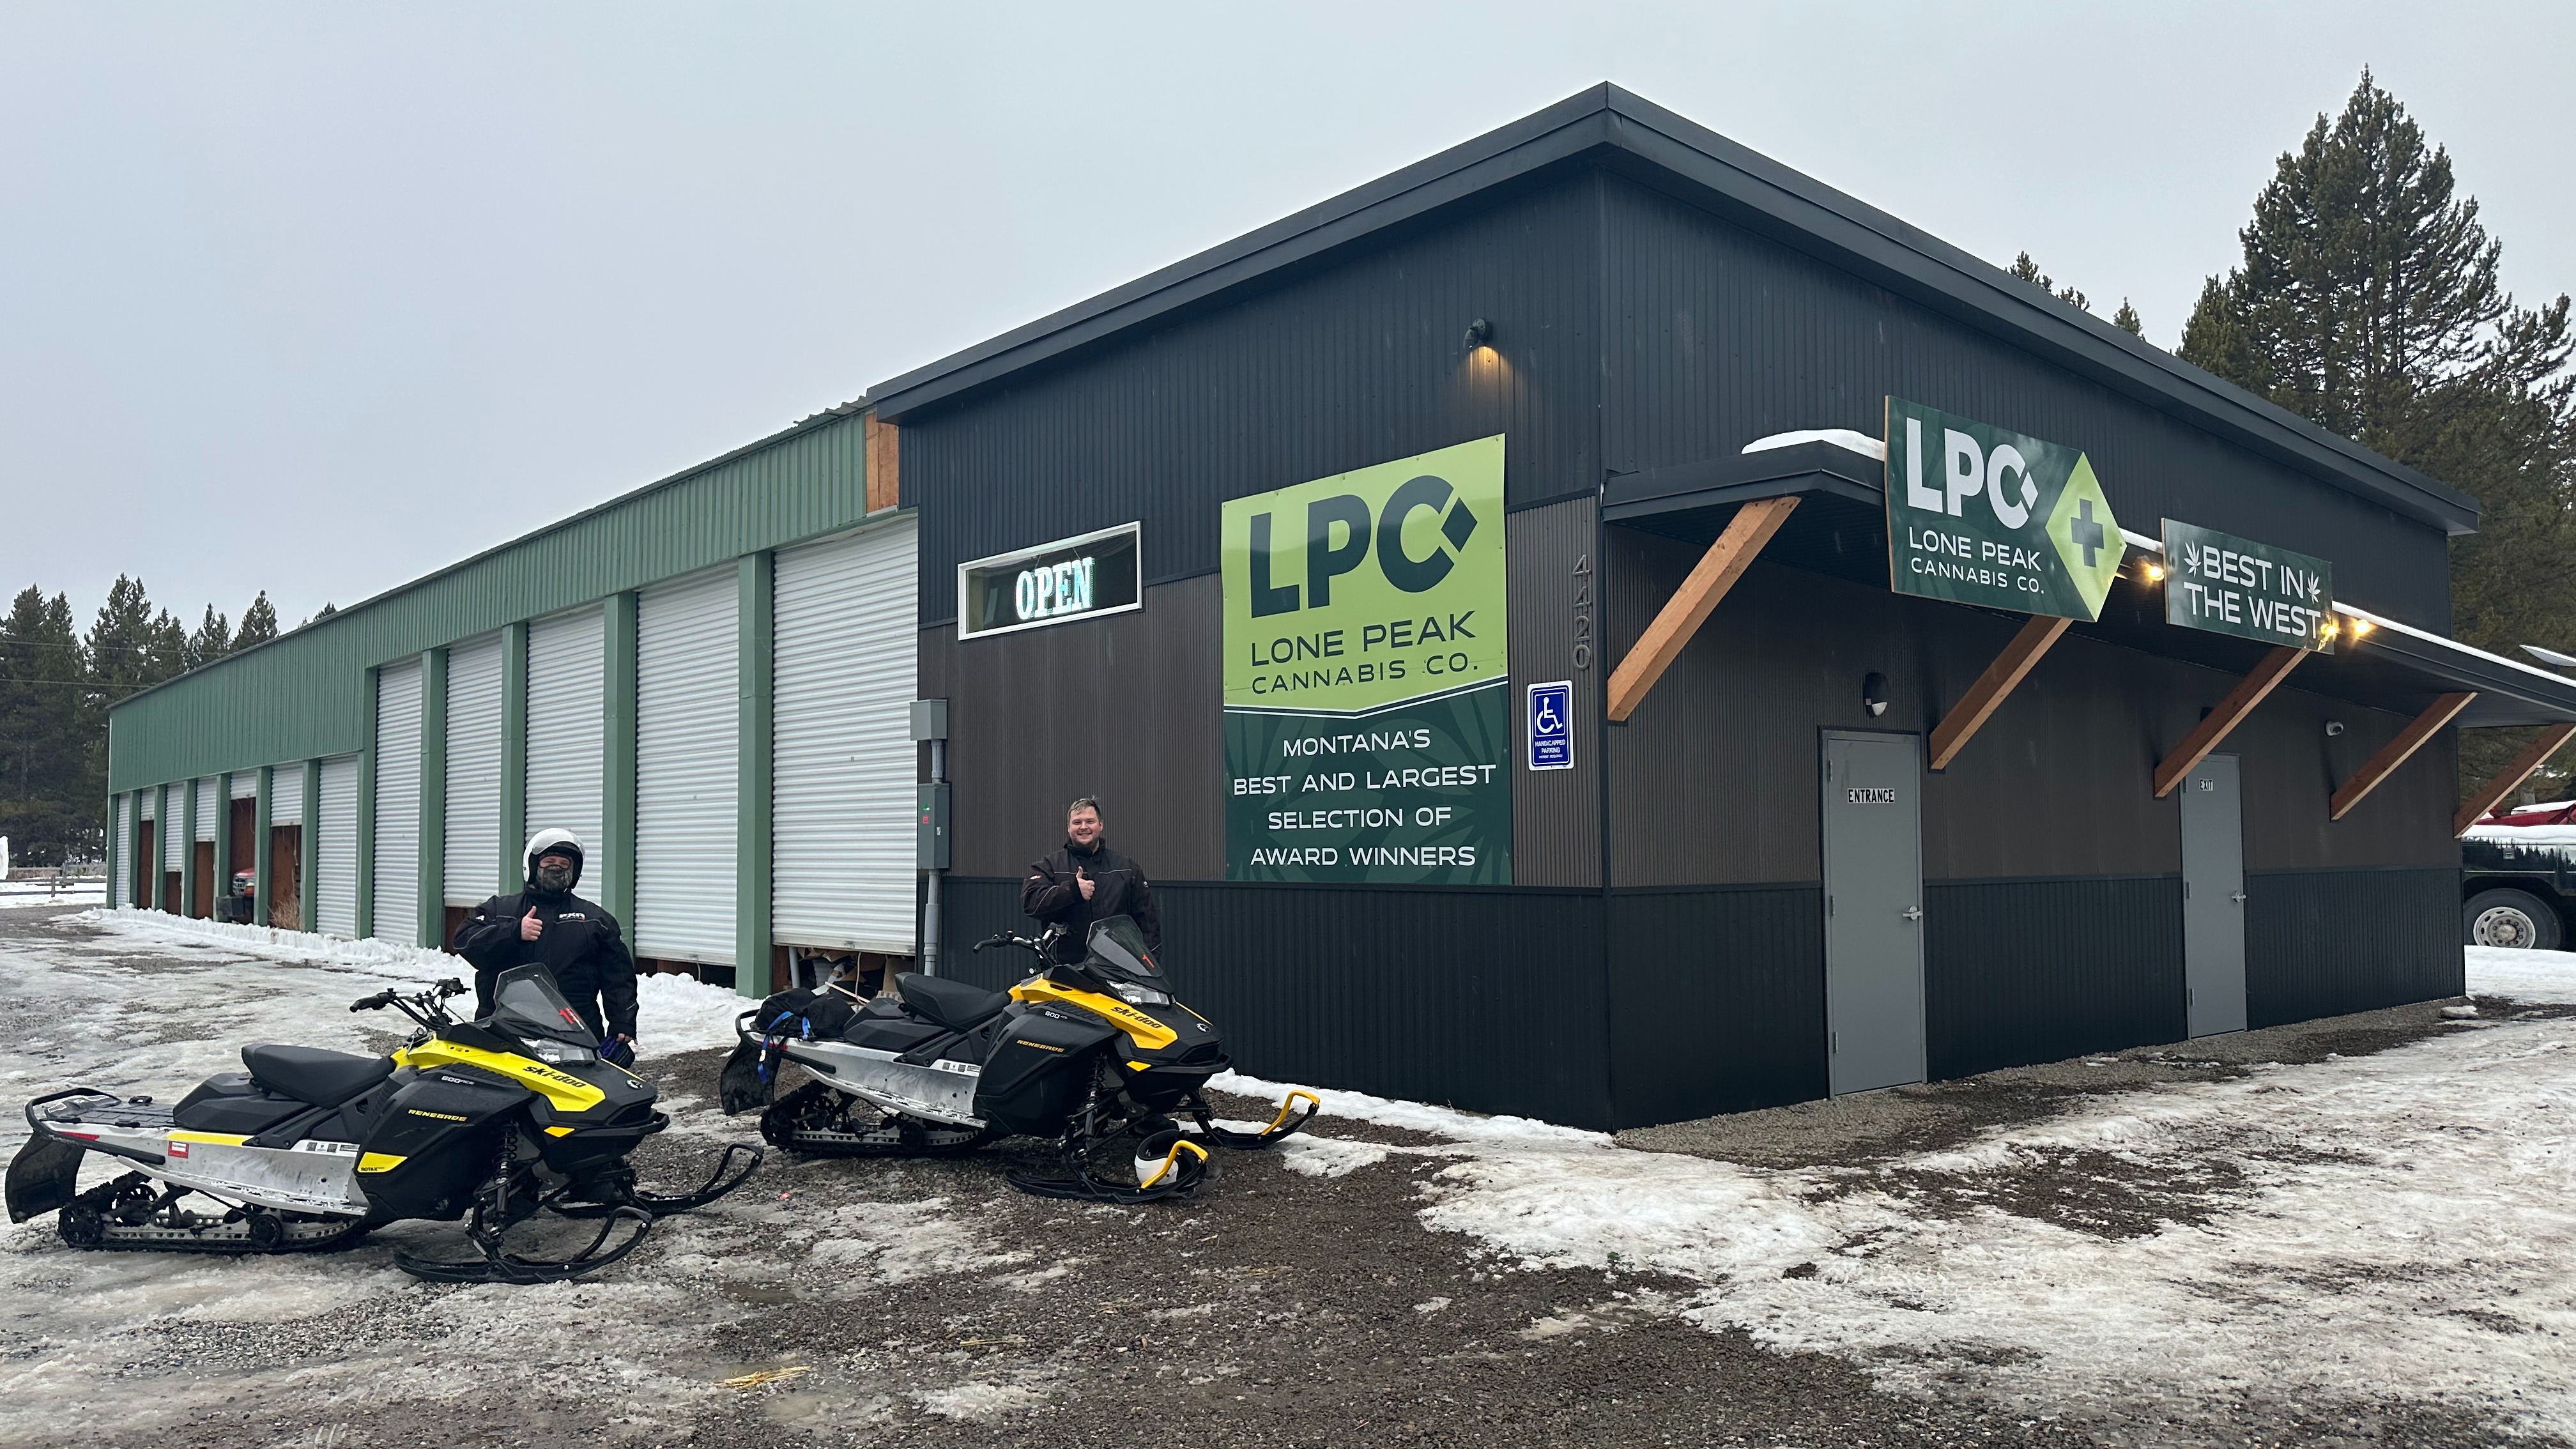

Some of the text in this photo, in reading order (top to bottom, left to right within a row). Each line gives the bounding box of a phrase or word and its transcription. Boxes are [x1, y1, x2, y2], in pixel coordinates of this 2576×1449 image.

[1906, 417, 2029, 529] LPC
[1250, 475, 1455, 618] LPC
[1909, 527, 2042, 572] LONE PEAK
[1016, 556, 1094, 620] OPEN
[1911, 557, 2044, 594] CANNABIS CO.
[2203, 546, 2304, 599] BEST IN
[1572, 555, 1593, 670] 4420
[2184, 582, 2321, 639] THE WEST
[1252, 610, 1476, 666] LONE PEAK
[1252, 652, 1478, 694] CANNABIS CO.
[1283, 728, 1431, 757] MONTANA'S
[1234, 764, 1497, 795] BEST AND LARGEST
[1848, 788, 1894, 803] ENTRANCE
[2200, 779, 2212, 790] EXIT
[1268, 806, 1452, 830] SELECTION OF
[1250, 847, 1476, 866] AWARD WINNERS
[1110, 1006, 1163, 1029] ski-doo
[1016, 1039, 1065, 1052] RENEGADE
[523, 1066, 586, 1088] ski-doo
[408, 1109, 468, 1122] RENEGADE
